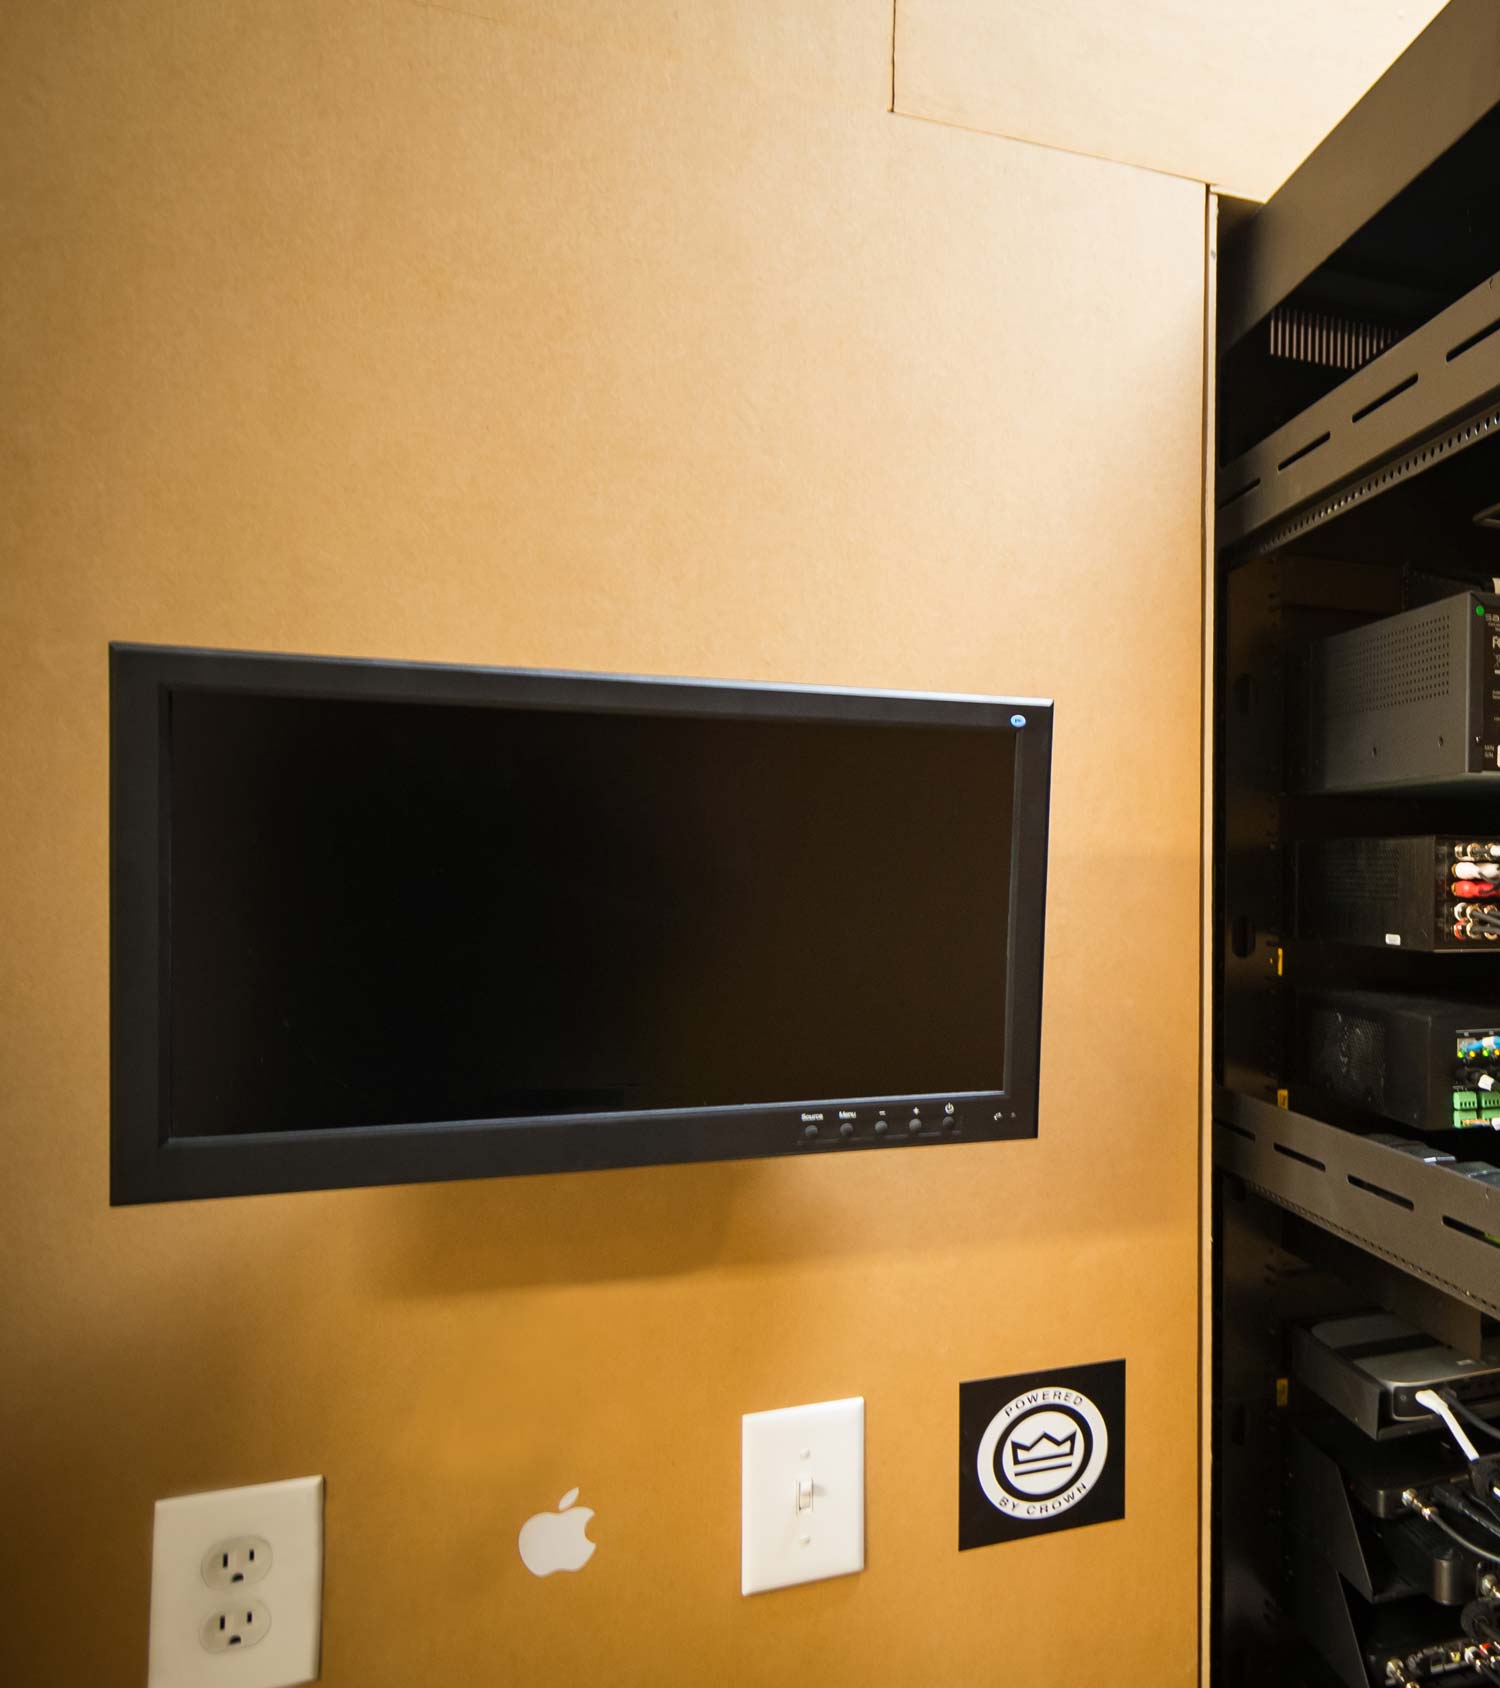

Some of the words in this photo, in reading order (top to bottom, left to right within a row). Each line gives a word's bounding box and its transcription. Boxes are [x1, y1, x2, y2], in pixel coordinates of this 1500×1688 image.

[838, 1110, 857, 1120] Menu
[1004, 1389, 1084, 1417] POWERED
[998, 1496, 1020, 1512] BY
[1026, 1482, 1088, 1516] CROWN
